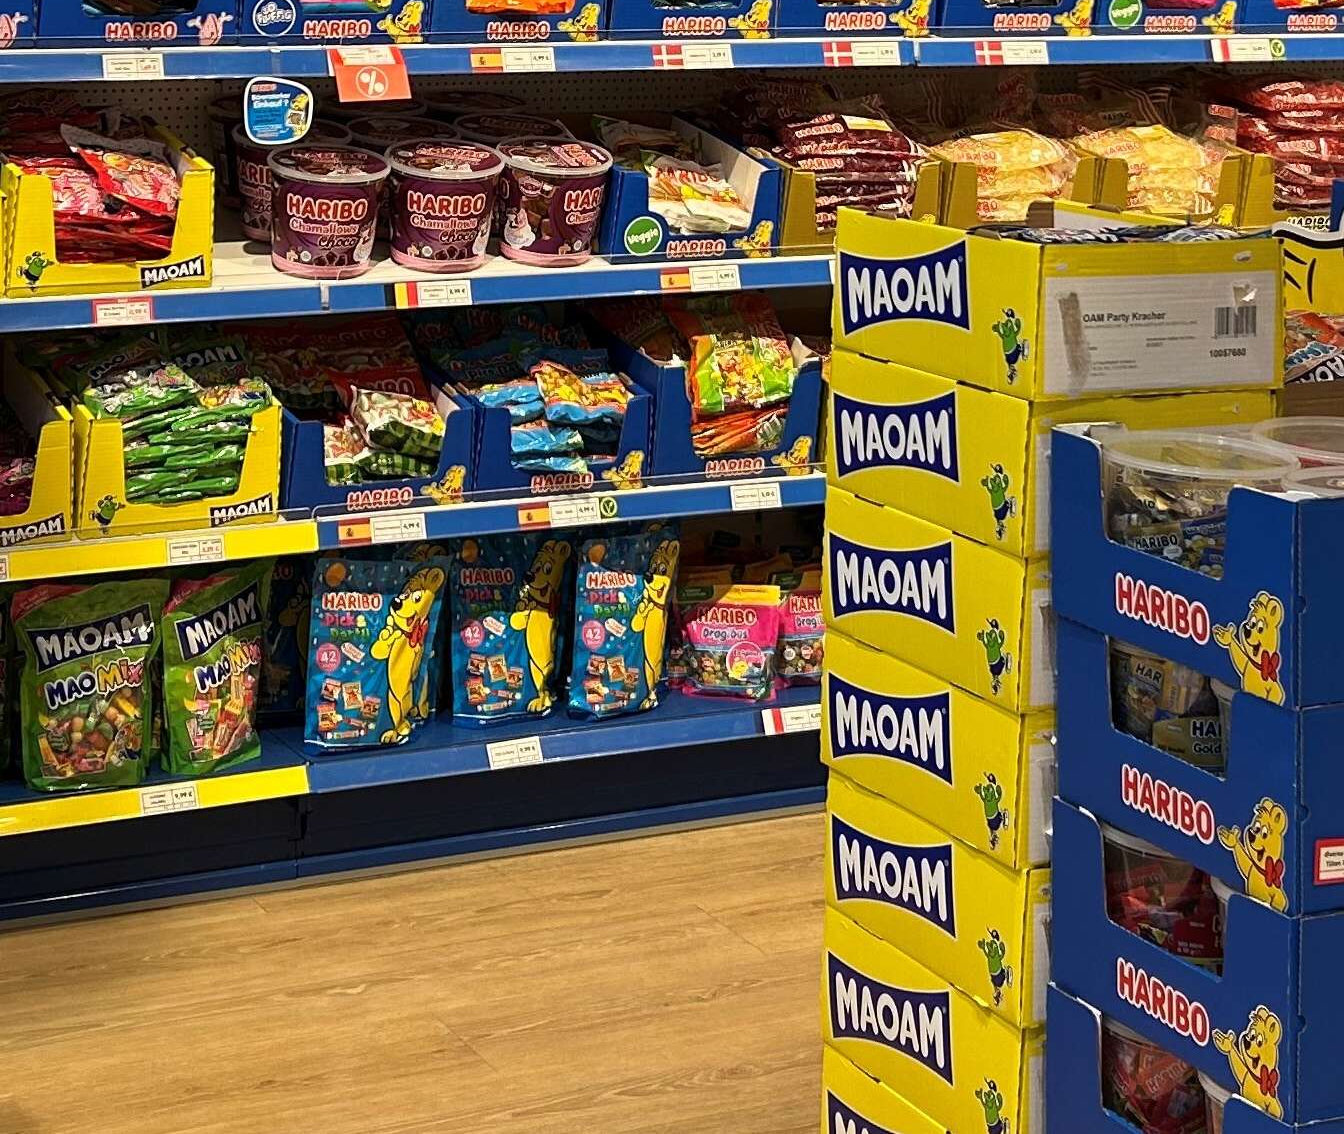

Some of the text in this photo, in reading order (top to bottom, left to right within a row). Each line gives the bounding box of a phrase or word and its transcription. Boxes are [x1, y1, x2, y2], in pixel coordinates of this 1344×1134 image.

[105, 21, 179, 41] HARIBO
[304, 19, 373, 39] HARIBO
[486, 20, 552, 40] HARIBO
[663, 17, 727, 37] HARIBO
[824, 11, 887, 31] HARIBO
[993, 14, 1053, 33] HARIBO
[1145, 14, 1197, 32] HARIBO
[1288, 13, 1340, 31] HARIBO
[288, 194, 368, 221] HARIBO
[408, 191, 486, 218] HARIBO
[292, 218, 359, 234] Chamallows
[411, 216, 477, 233] Chamallows
[628, 228, 659, 244] Veggie
[144, 259, 204, 282] MAOAM
[847, 257, 963, 324] MAOAM
[1107, 310, 1166, 325] Party Kracher
[840, 407, 952, 471] MAOAM
[706, 458, 763, 477] HARIBO
[529, 473, 592, 493] HARIBO
[212, 498, 270, 518] MAOAM
[343, 488, 409, 512] HARIBO
[0, 518, 62, 544] MAOAM
[586, 571, 634, 588] HARIBO
[836, 548, 947, 621] MAOAM
[322, 592, 381, 610] HARIBO
[1118, 576, 1208, 642] HARIBO
[185, 593, 256, 656] MAOAM
[463, 627, 481, 641] 42
[584, 628, 601, 641] 42
[35, 612, 149, 665] MAOAM
[322, 650, 342, 664] 42
[835, 691, 944, 771] MAOAM
[1122, 765, 1213, 844] HARIBO
[838, 833, 948, 923] MAOAM
[1118, 958, 1209, 1044] HARIBO
[834, 972, 943, 1070] MAOAM
